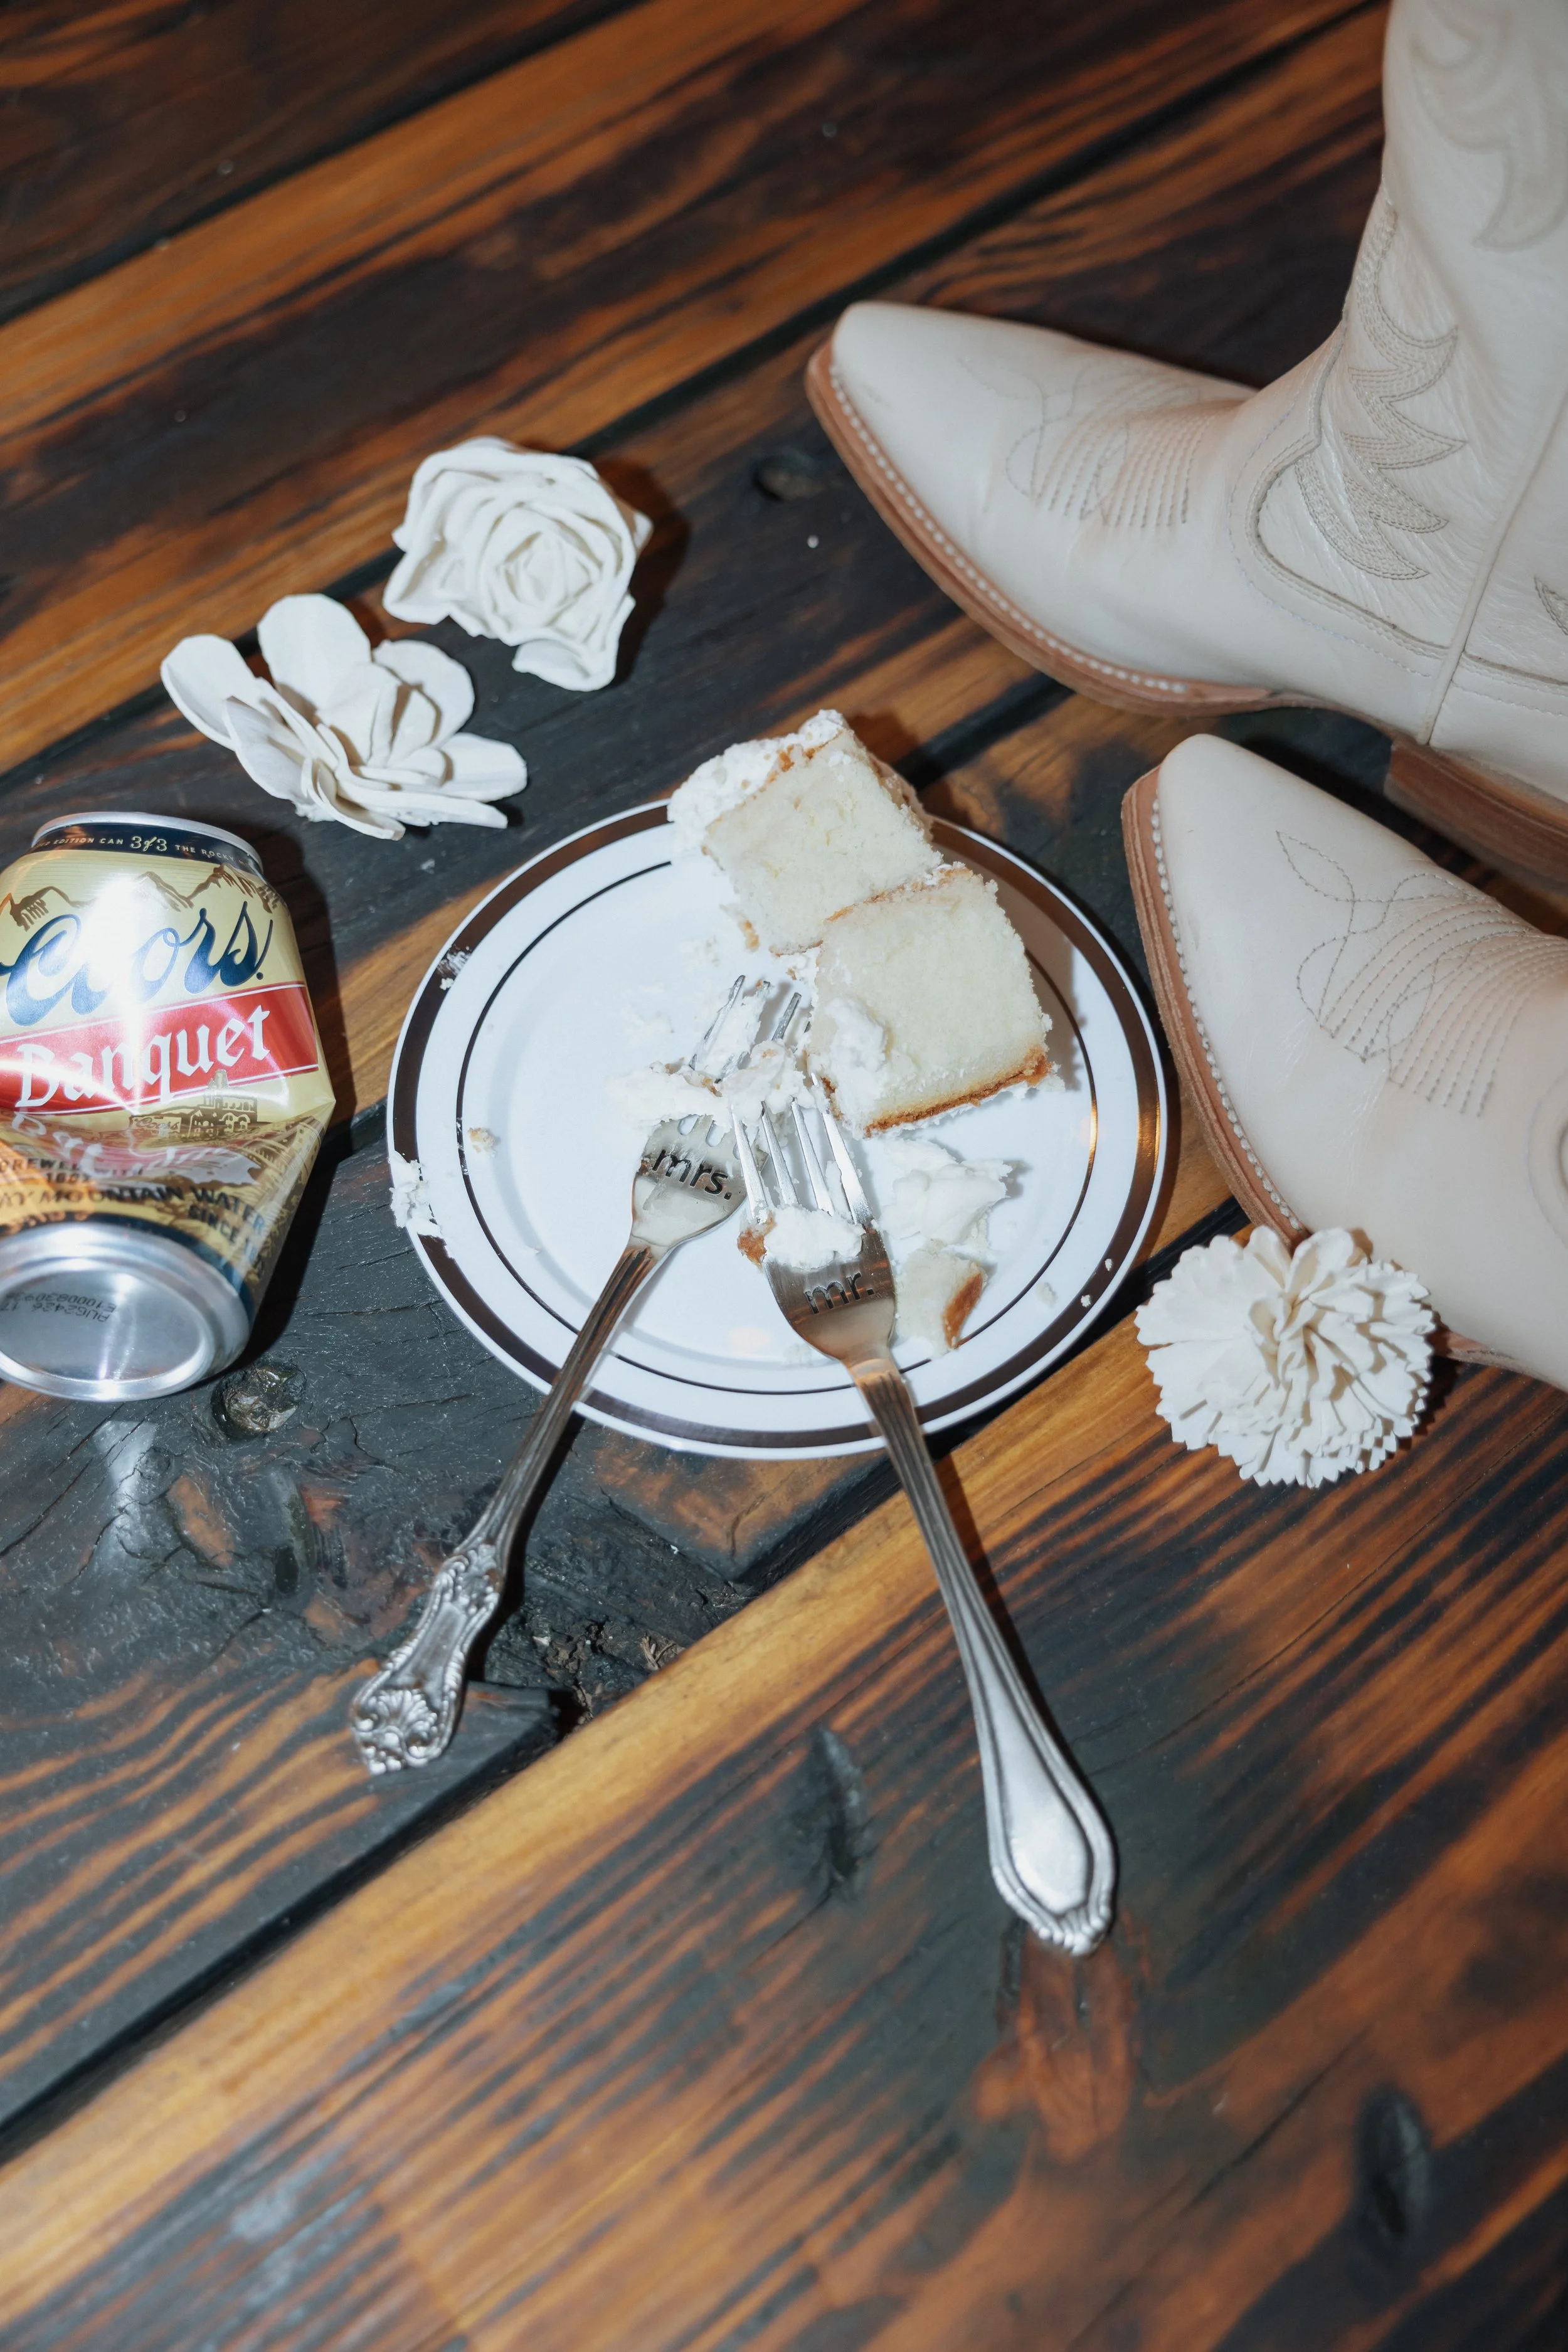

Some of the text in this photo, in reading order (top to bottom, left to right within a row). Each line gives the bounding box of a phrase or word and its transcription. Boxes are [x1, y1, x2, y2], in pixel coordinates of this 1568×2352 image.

[174, 844, 196, 854] THE
[201, 848, 235, 862] ROCKY
[0, 901, 273, 1027] Coors
[15, 1005, 270, 1108] Banquet
[651, 1149, 732, 1200] mrs.
[805, 1271, 874, 1314] mr.
